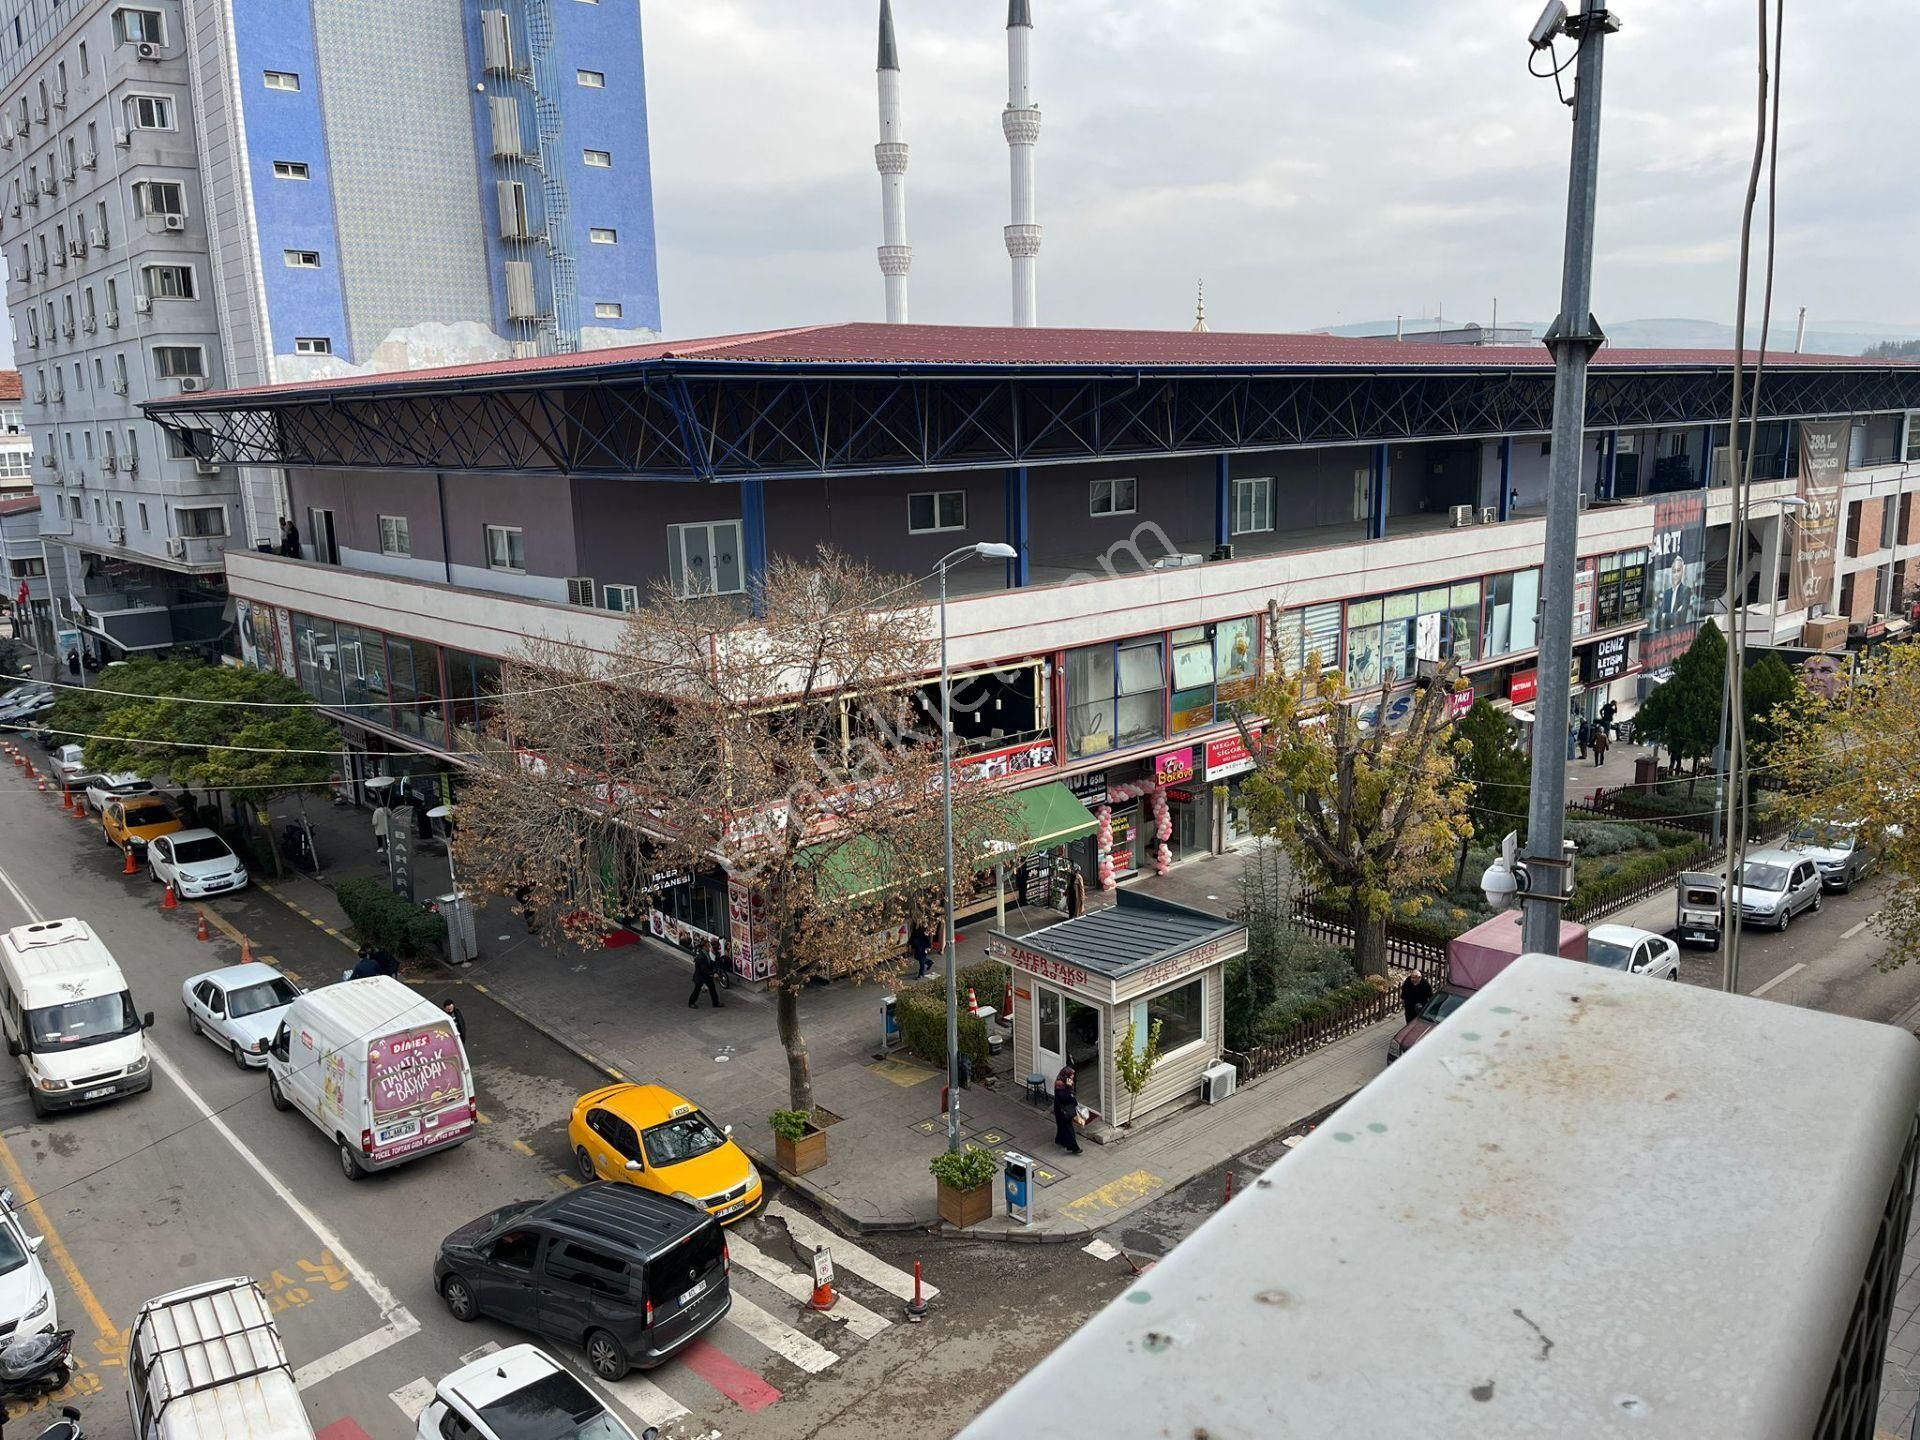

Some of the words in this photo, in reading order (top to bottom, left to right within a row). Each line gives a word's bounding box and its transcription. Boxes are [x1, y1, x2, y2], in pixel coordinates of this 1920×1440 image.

[1598, 636, 1625, 656] DENİZ
[1212, 740, 1235, 751] MEGA
[1216, 746, 1242, 758] SİGOR
[1089, 773, 1105, 786] GSM
[1010, 946, 1047, 971] ZAFER
[1143, 959, 1179, 982] ZAFER
[984, 1133, 1001, 1144] 5
[391, 1143, 411, 1156] TOPTAN
